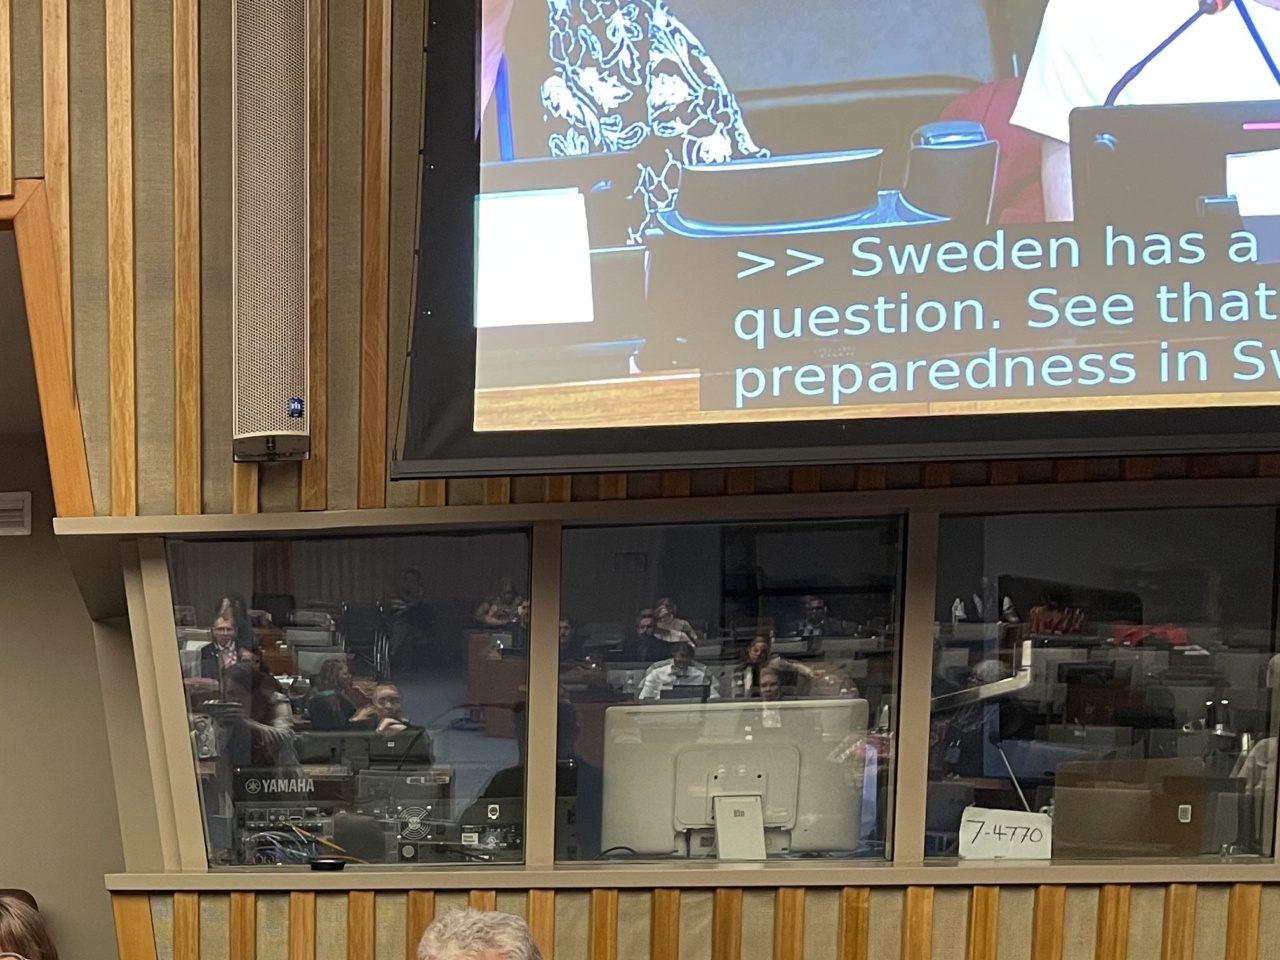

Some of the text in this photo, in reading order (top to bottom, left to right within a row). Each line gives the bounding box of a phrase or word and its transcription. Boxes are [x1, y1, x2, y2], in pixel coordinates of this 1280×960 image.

[852, 230, 1080, 277] Sweden
[1106, 225, 1206, 266] has
[1228, 230, 1258, 263] a
[734, 281, 1278, 350] question. See that
[735, 347, 1137, 409] preparedness
[1160, 341, 1208, 383] in
[262, 779, 315, 793] YAMAHA
[966, 819, 1043, 845] 7-4770
